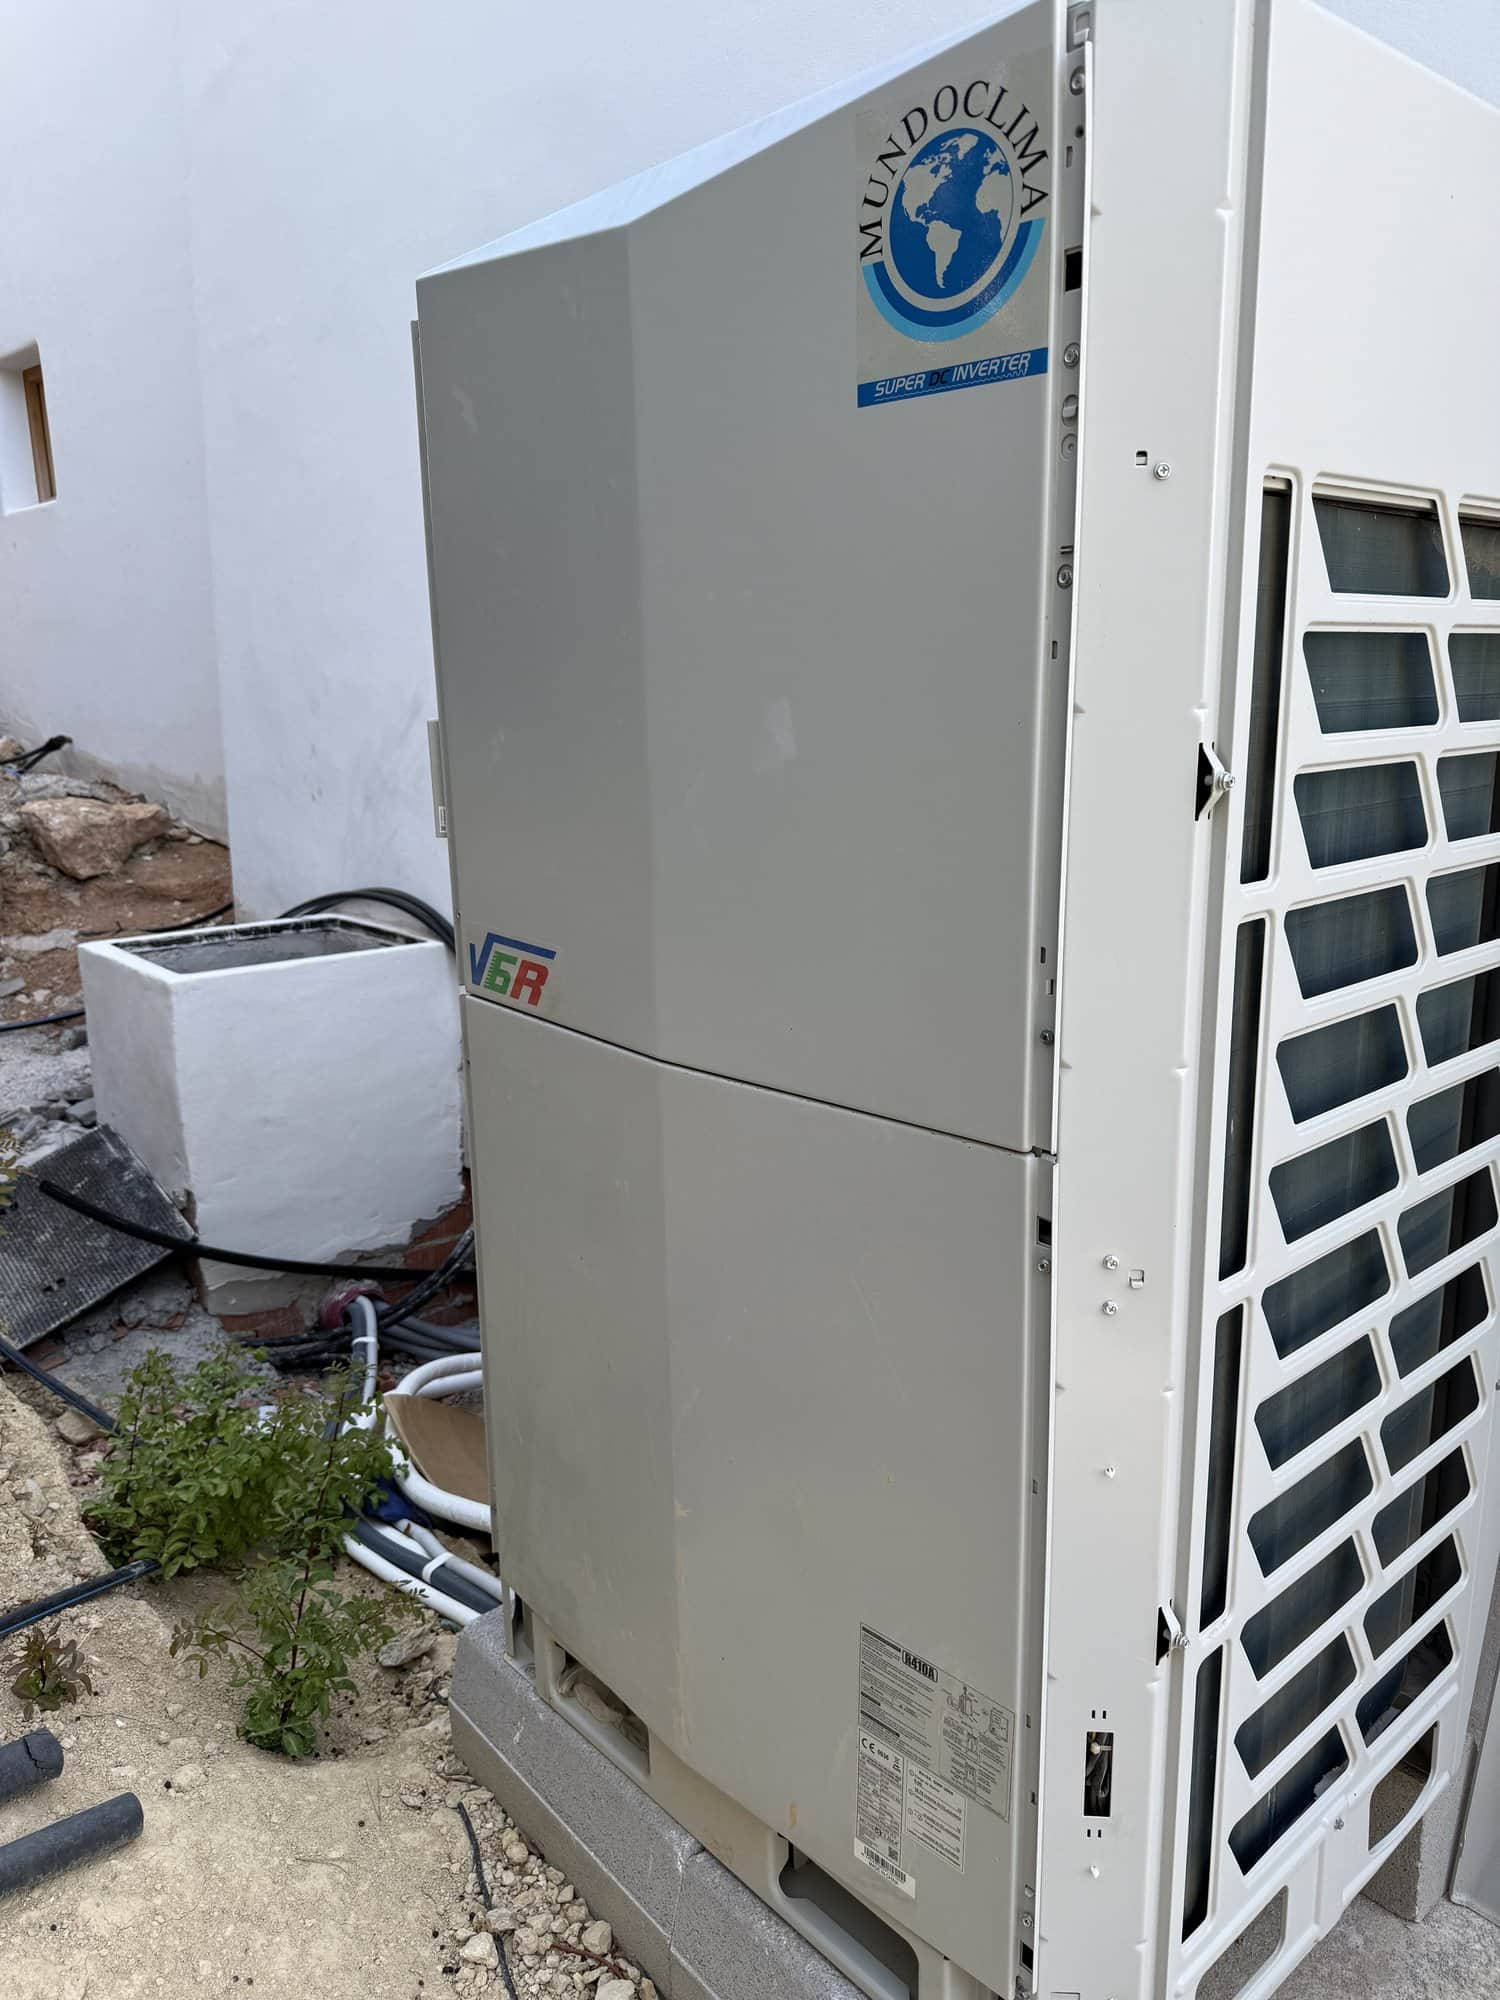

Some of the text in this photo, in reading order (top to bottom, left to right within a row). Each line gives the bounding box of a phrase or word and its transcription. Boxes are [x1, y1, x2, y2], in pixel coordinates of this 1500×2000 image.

[859, 80, 1048, 263] MUNDOCLIMA
[874, 352, 1031, 397] SUPER DC INVERTER
